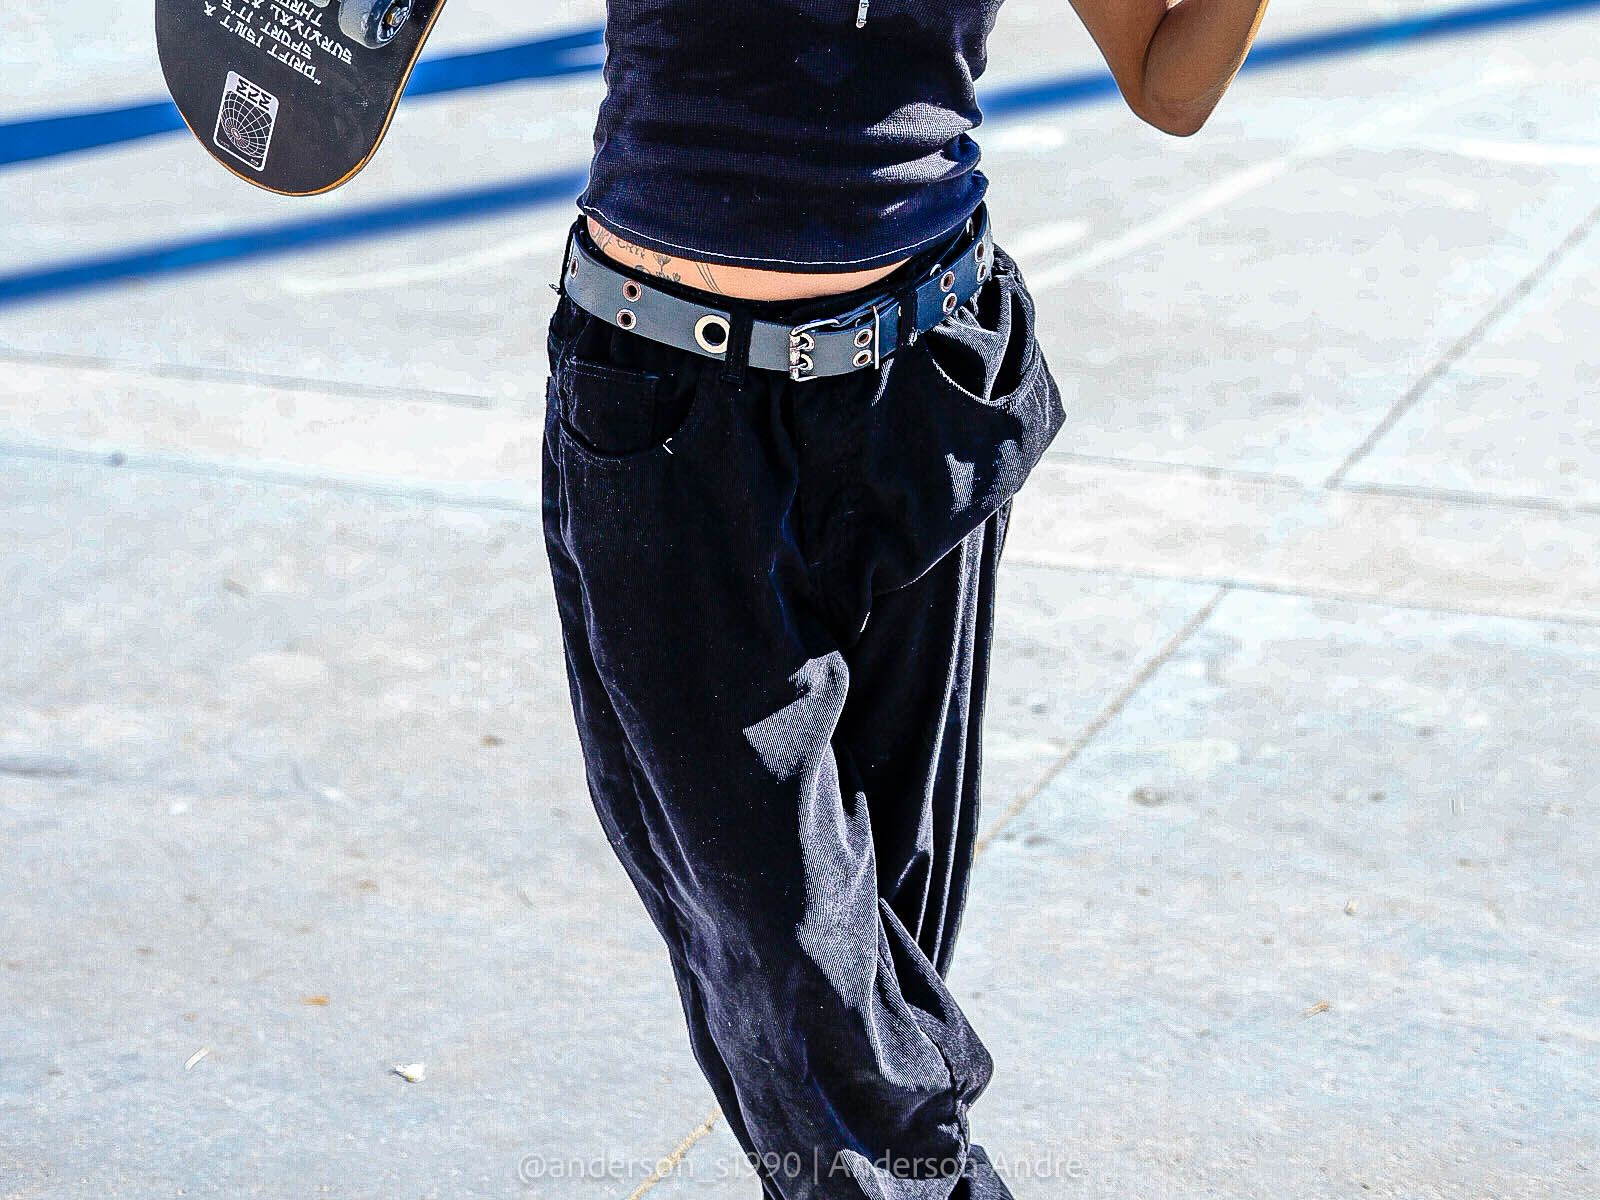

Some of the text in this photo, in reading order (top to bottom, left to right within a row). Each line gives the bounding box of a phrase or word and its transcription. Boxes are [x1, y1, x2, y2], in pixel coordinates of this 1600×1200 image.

[204, 1, 216, 16] A
[220, 15, 263, 48] ISN'T
[260, 16, 312, 60] SPORT.
[270, 4, 352, 64] SURVIVAL
